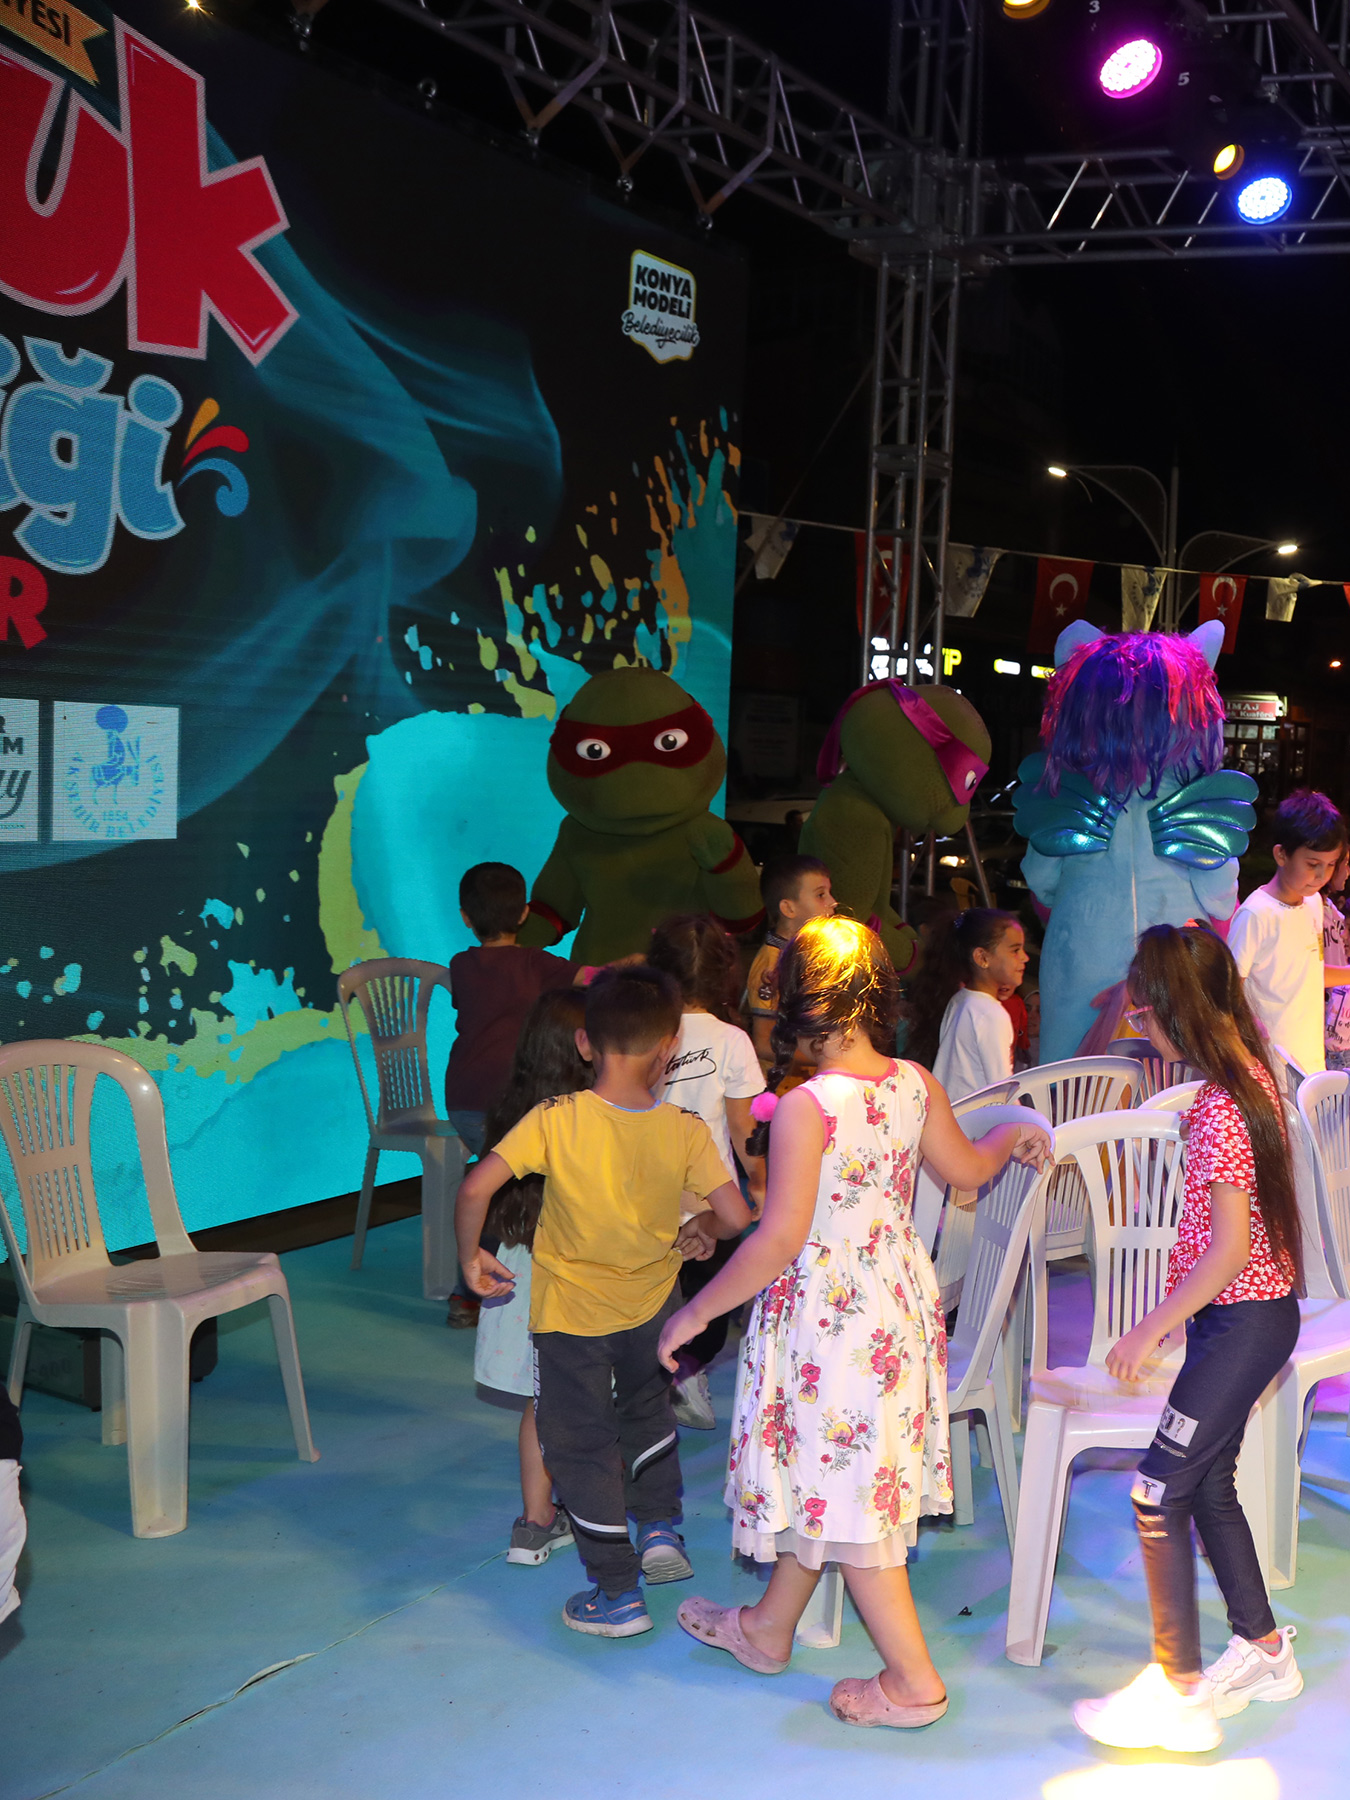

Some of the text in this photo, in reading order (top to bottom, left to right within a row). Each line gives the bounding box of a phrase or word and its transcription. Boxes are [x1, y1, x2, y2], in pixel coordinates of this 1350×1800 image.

[1088, 0, 1100, 14] 3
[1178, 72, 1190, 87] 5
[635, 264, 693, 299] KONYA
[622, 311, 700, 350] Belediyecilik
